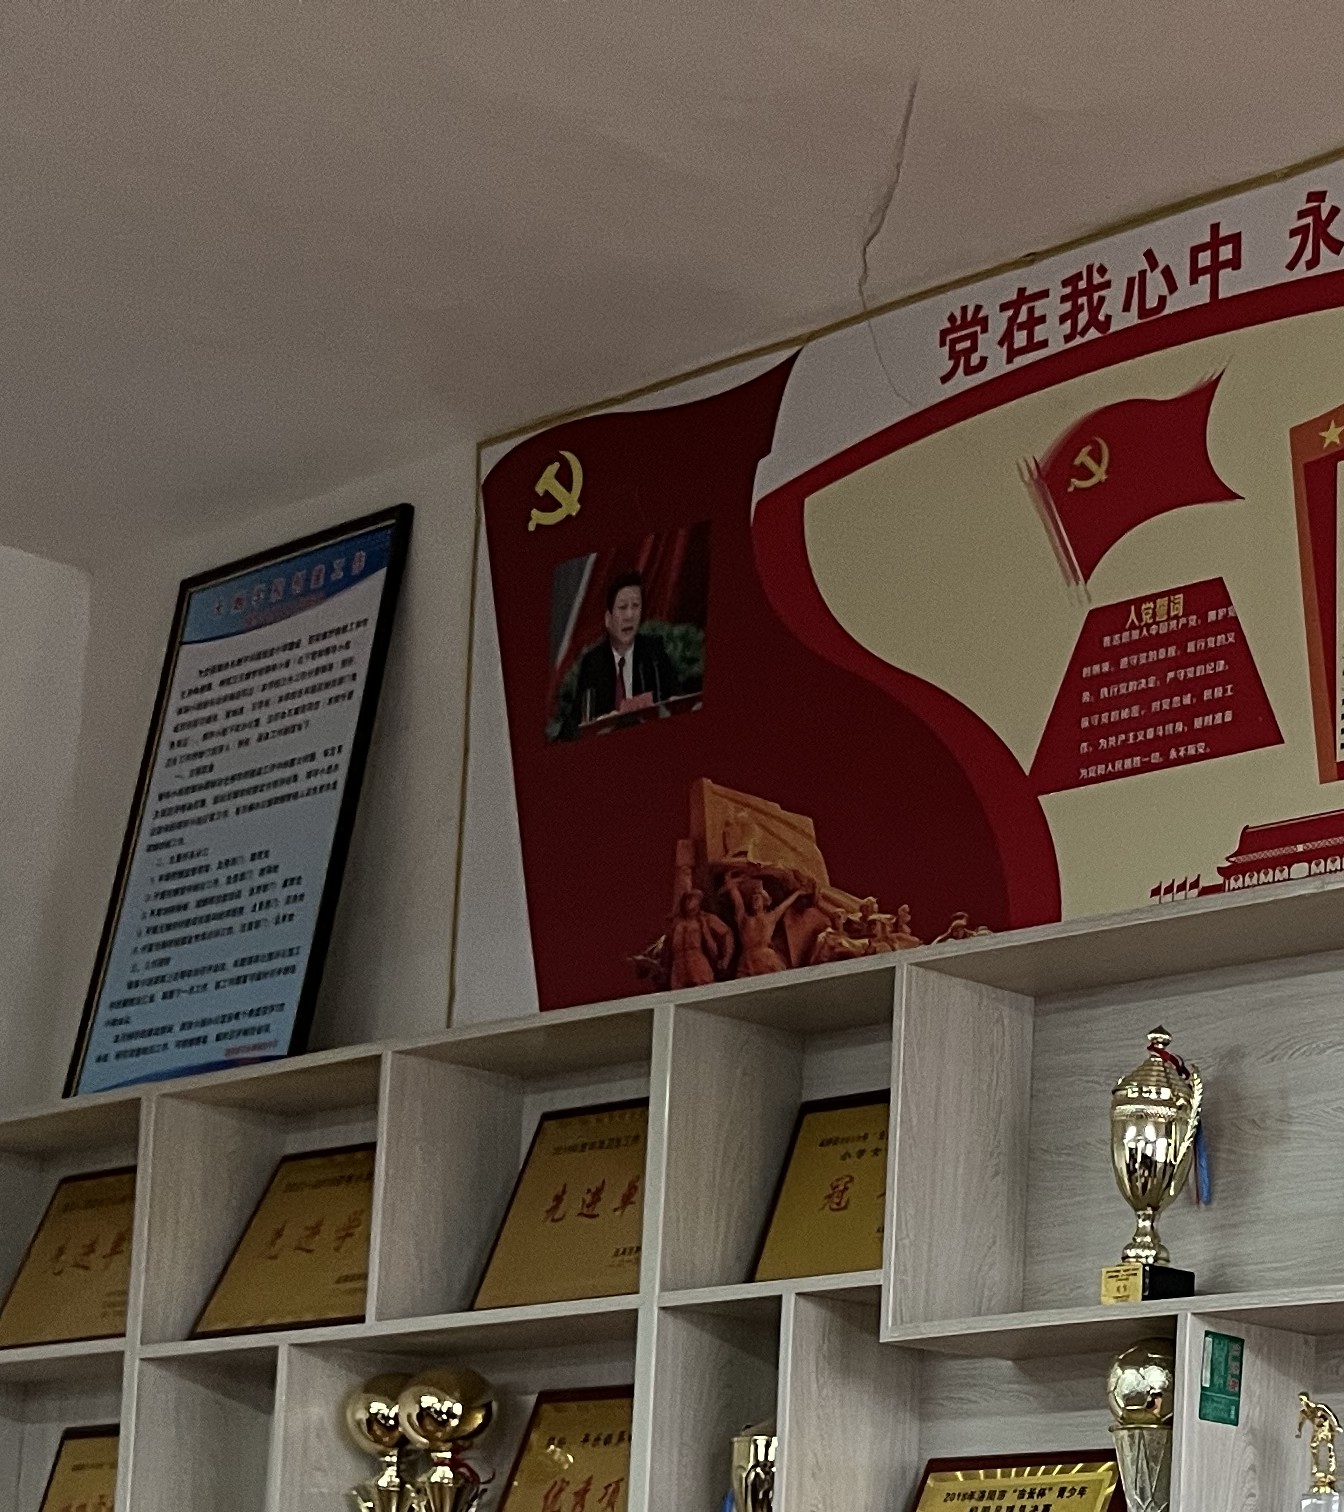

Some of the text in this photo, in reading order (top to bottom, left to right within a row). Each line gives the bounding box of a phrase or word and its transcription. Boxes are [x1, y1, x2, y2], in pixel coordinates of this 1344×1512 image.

[937, 223, 1244, 384] 党在我心中
